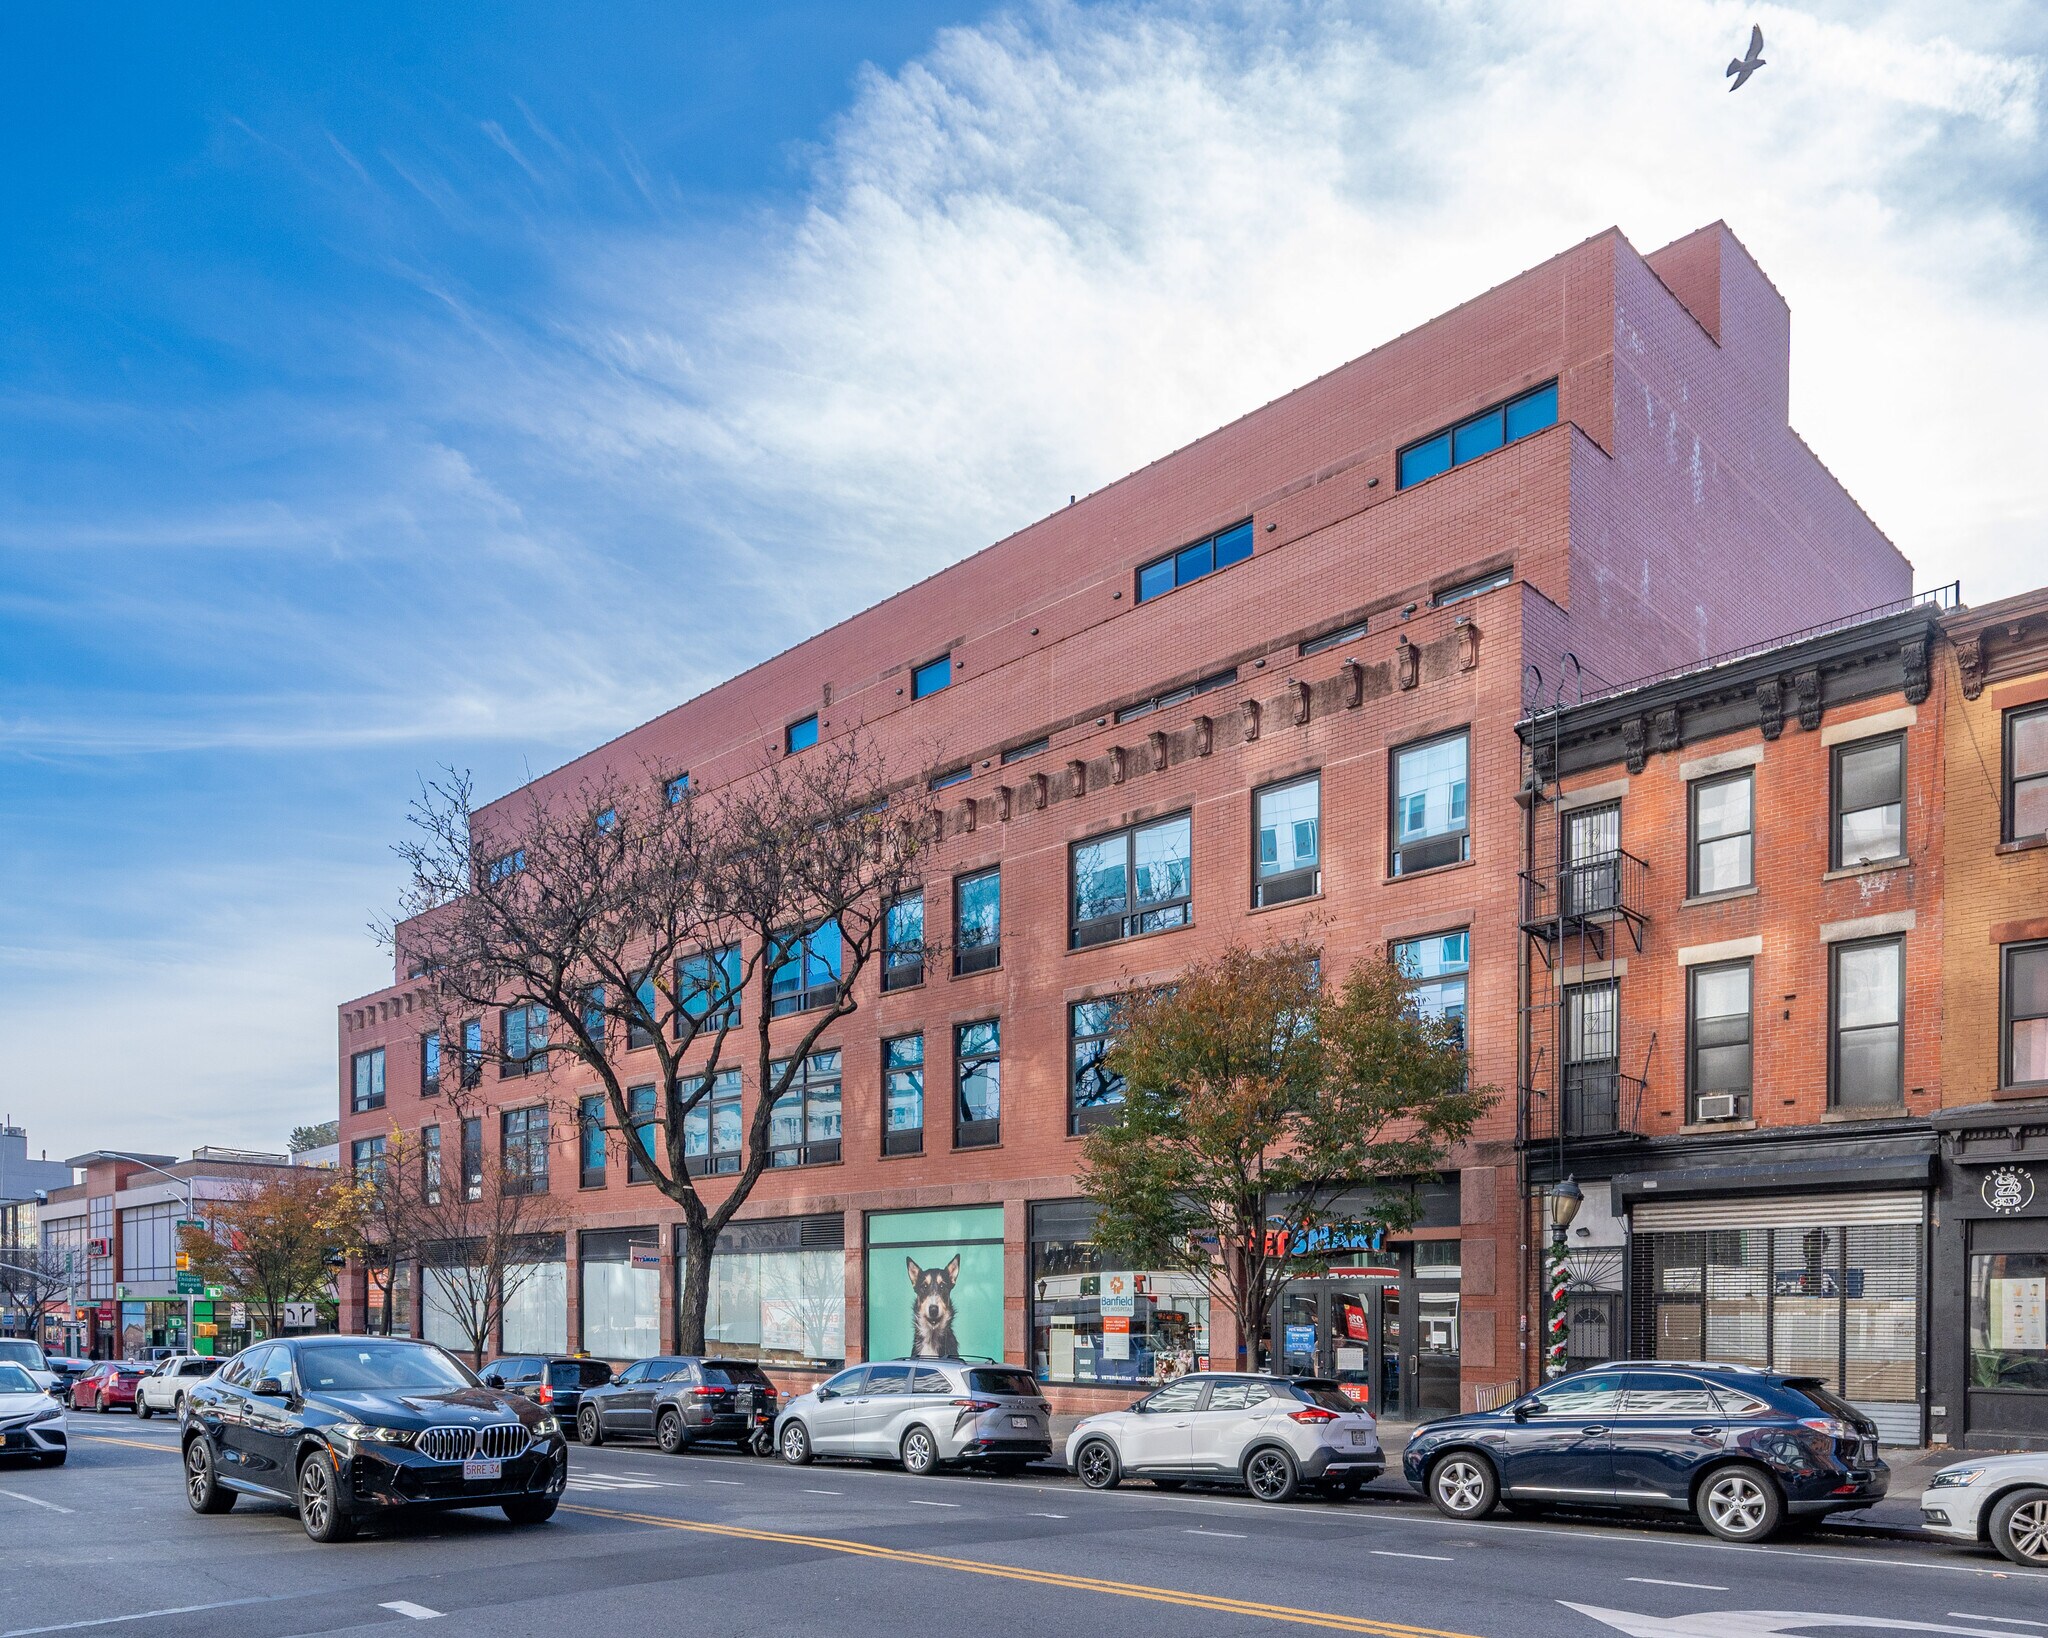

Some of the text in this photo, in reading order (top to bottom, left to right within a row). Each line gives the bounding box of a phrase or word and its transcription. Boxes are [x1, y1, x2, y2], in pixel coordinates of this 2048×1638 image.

[1985, 1166, 2031, 1181] DRAGON
[1995, 1206, 2021, 1215] TEA
[206, 1287, 222, 1297] TD
[1101, 1295, 1133, 1306] Banfield
[169, 1318, 182, 1326] TD
[466, 1463, 500, 1475] 5RRE 34
